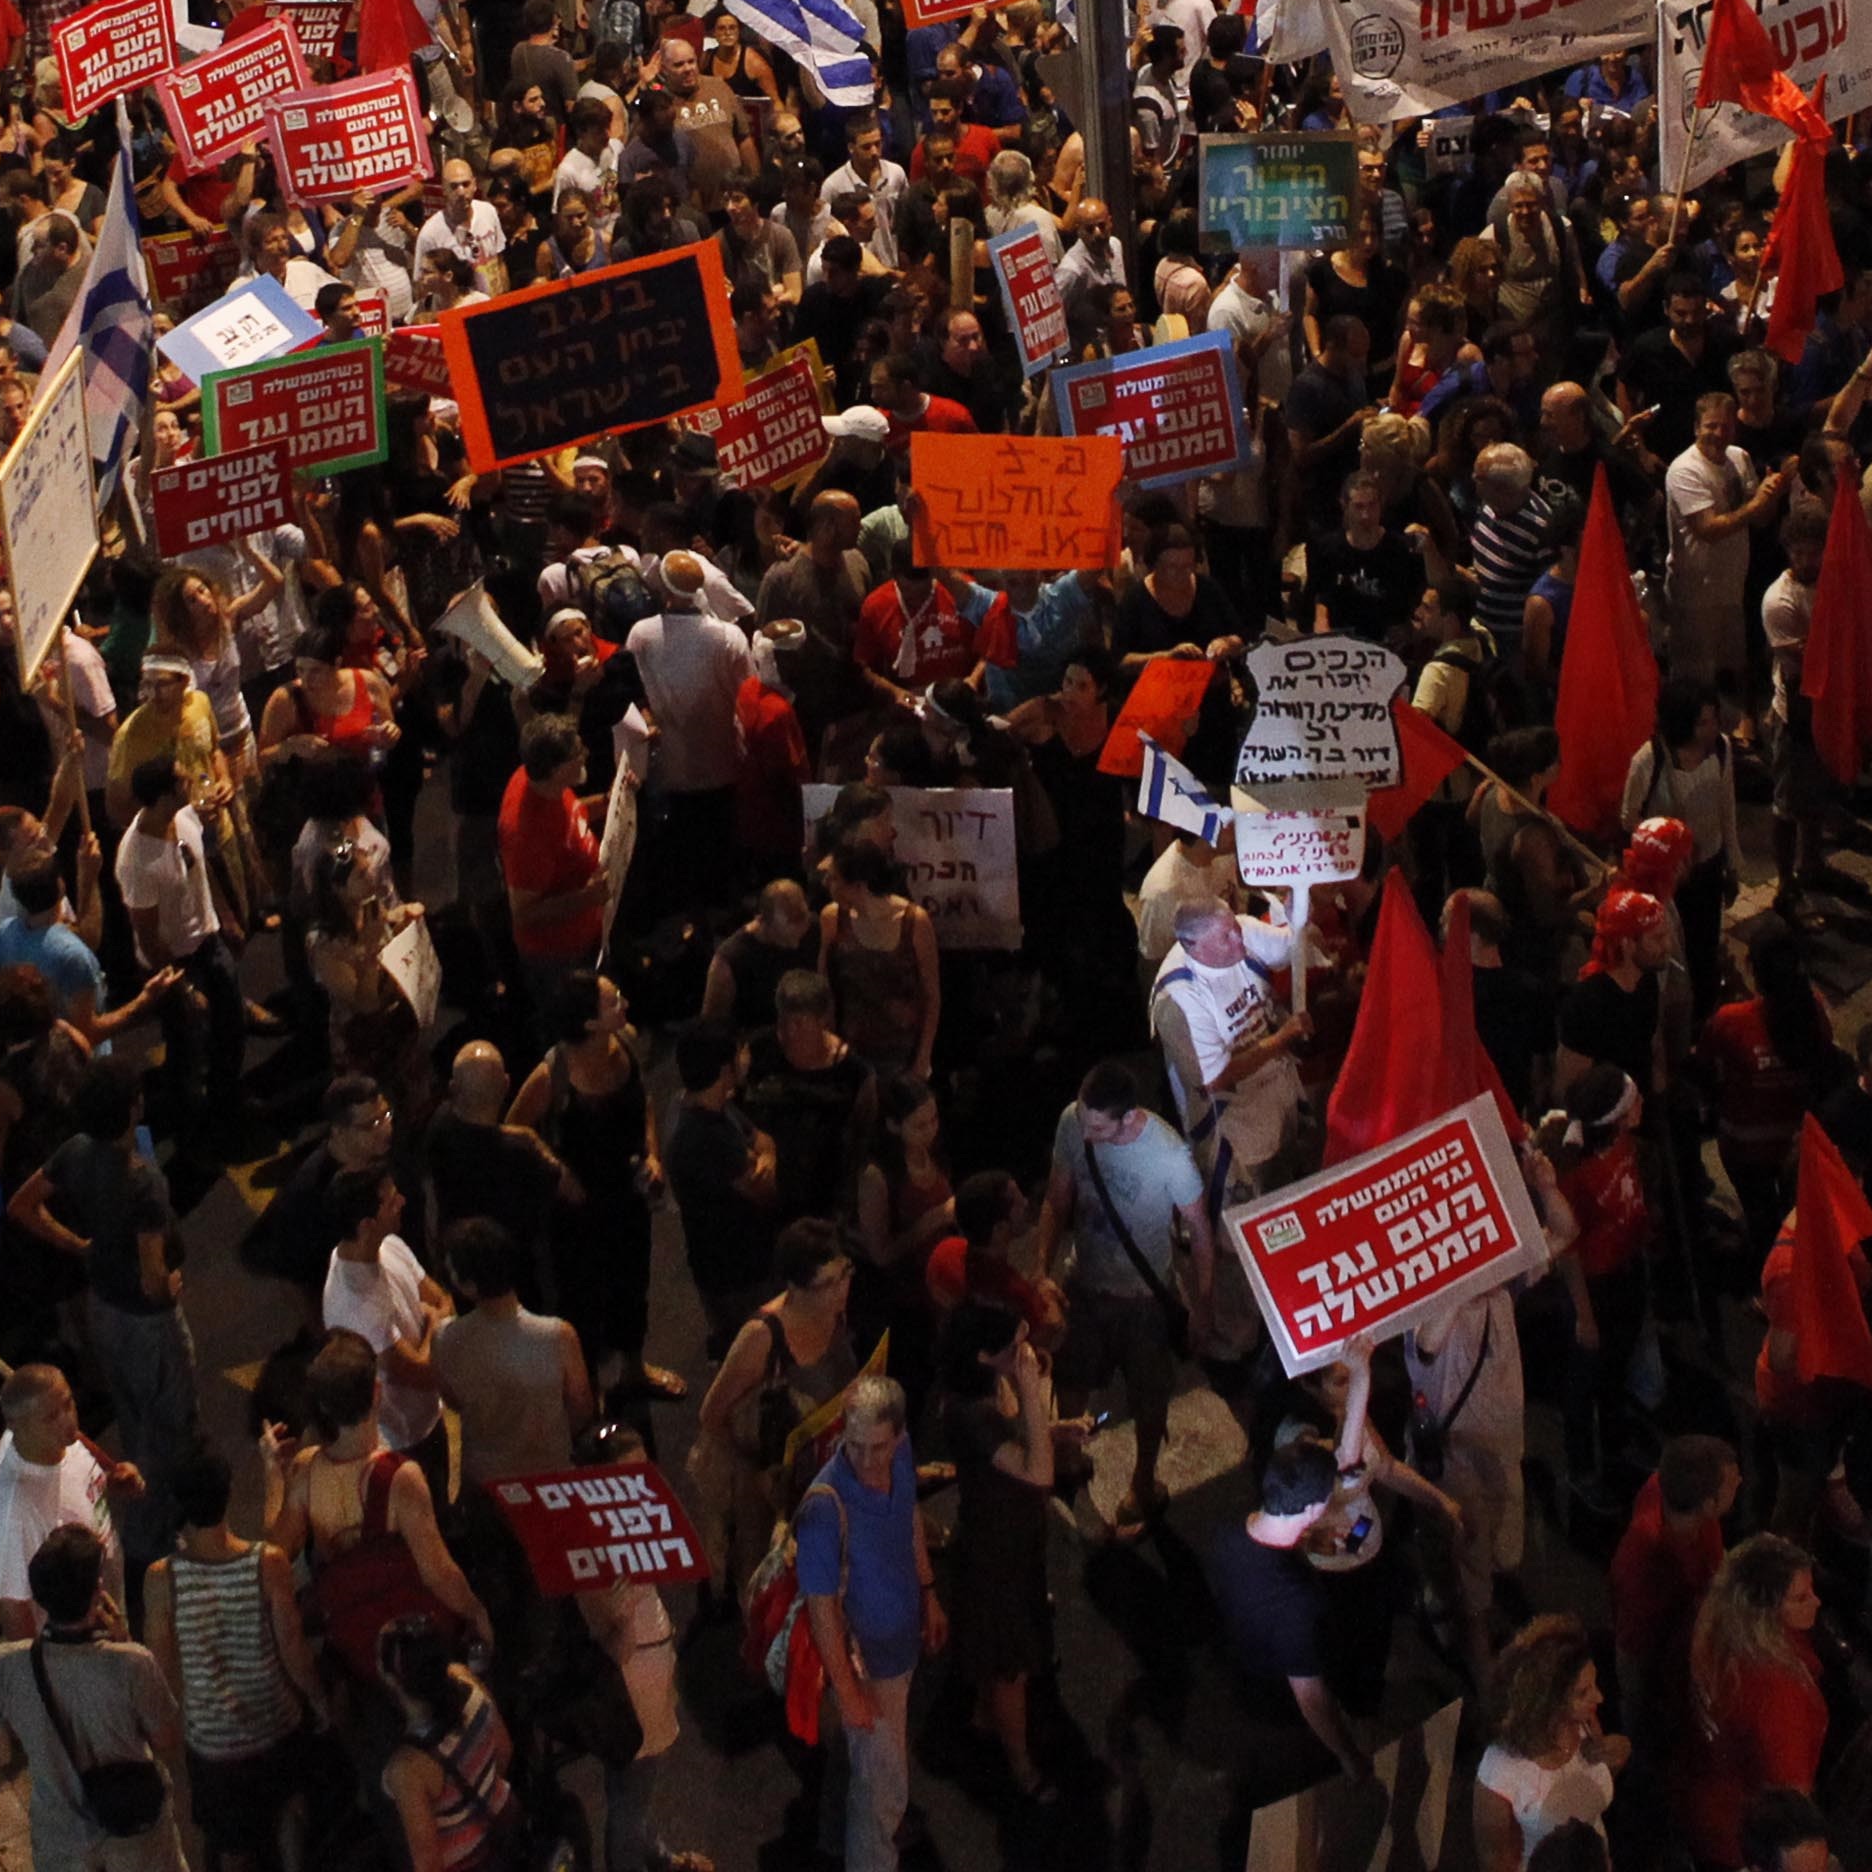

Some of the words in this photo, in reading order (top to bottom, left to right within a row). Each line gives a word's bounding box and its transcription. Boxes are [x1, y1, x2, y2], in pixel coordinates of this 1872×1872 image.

[88, 1, 157, 38] כשהממשלה
[109, 22, 138, 39] העם
[138, 14, 158, 28] נגד
[297, 24, 340, 39] לפני
[114, 29, 162, 58] העם
[75, 47, 164, 102] הממשלה
[79, 47, 109, 75] נגד
[206, 40, 283, 84] כשהממשלה
[235, 65, 259, 85] העם
[261, 54, 287, 74] נגד
[241, 67, 292, 102] העם
[196, 88, 236, 120] נגד
[315, 94, 401, 124] כשהממשלה
[377, 109, 404, 127] נגד
[345, 116, 375, 135] העם
[351, 124, 409, 156] העם
[295, 148, 413, 189] הממשלה
[300, 141, 342, 164] נגד
[1232, 162, 1328, 191] הדיור
[535, 279, 656, 337] בנגב
[262, 362, 364, 397] כשהממשלה
[498, 345, 595, 385] העם
[296, 386, 330, 404] העם
[333, 379, 364, 395] נגד
[727, 371, 805, 419] כשהממשלה
[785, 387, 810, 407] נגד
[1115, 366, 1215, 399] כשהממשלה
[1191, 381, 1218, 402] נגד
[299, 395, 366, 428] העם
[756, 402, 783, 423] העם
[1150, 392, 1189, 410] העם
[1156, 400, 1223, 434] העם
[238, 412, 289, 444] נגד
[763, 406, 817, 447] העם
[718, 437, 759, 466] נגד
[187, 449, 278, 491] אנשים
[216, 472, 281, 506] לפני
[187, 497, 285, 543] רווחים
[1315, 1138, 1466, 1228] כשהממשלה
[1433, 1158, 1474, 1190] נגד
[1373, 1188, 1428, 1225] העם
[1384, 1181, 1485, 1258] העם
[1293, 1212, 1500, 1340] הממשלה
[1296, 1240, 1379, 1295] נגד
[535, 1473, 659, 1511] אנשים
[588, 1499, 674, 1538] לפני
[566, 1537, 695, 1582] רווחים
